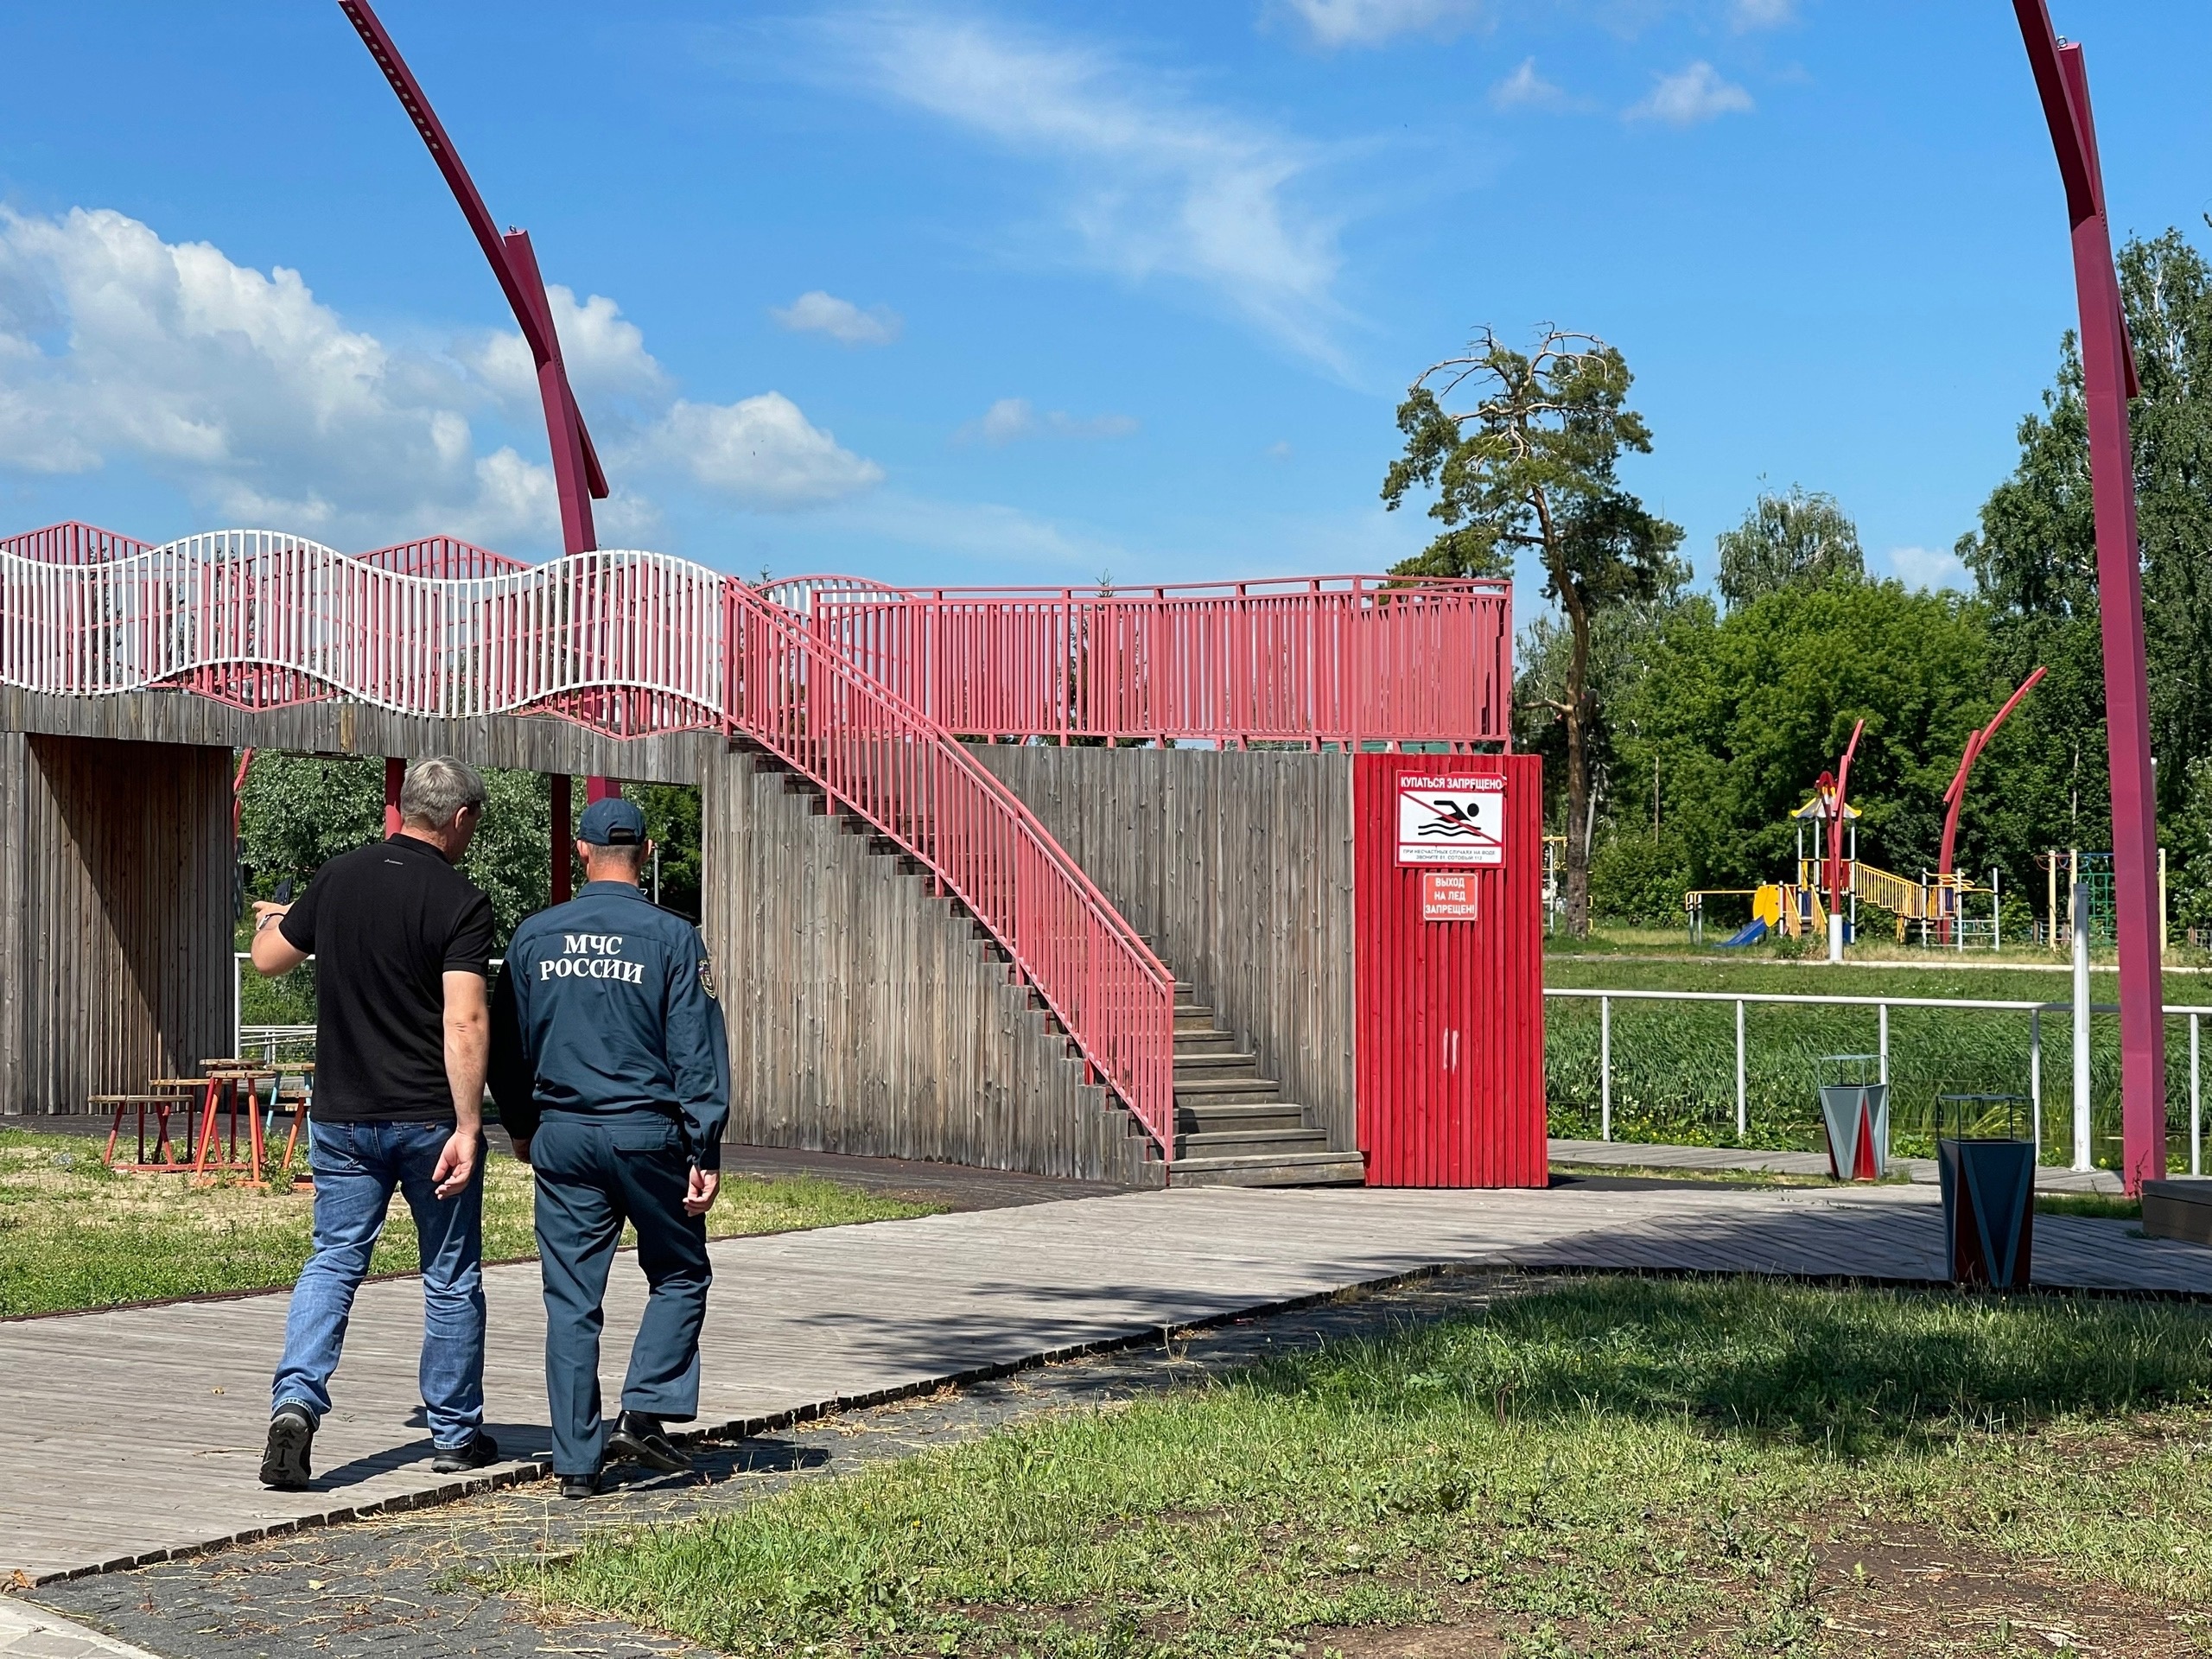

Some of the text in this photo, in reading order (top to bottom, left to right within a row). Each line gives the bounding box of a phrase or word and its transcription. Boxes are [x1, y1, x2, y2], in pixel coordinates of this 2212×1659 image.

[1401, 777, 1503, 790] КУПАТЬСЯ ЗАПРЕЩЕНО
[1435, 878, 1465, 888] ВЫХОД
[1434, 891, 1465, 901] НА ЛЕД
[1425, 905, 1475, 916] ЗАПРЕЩЕН!
[563, 934, 622, 955] МЧС
[539, 957, 645, 984] РОССИИ
